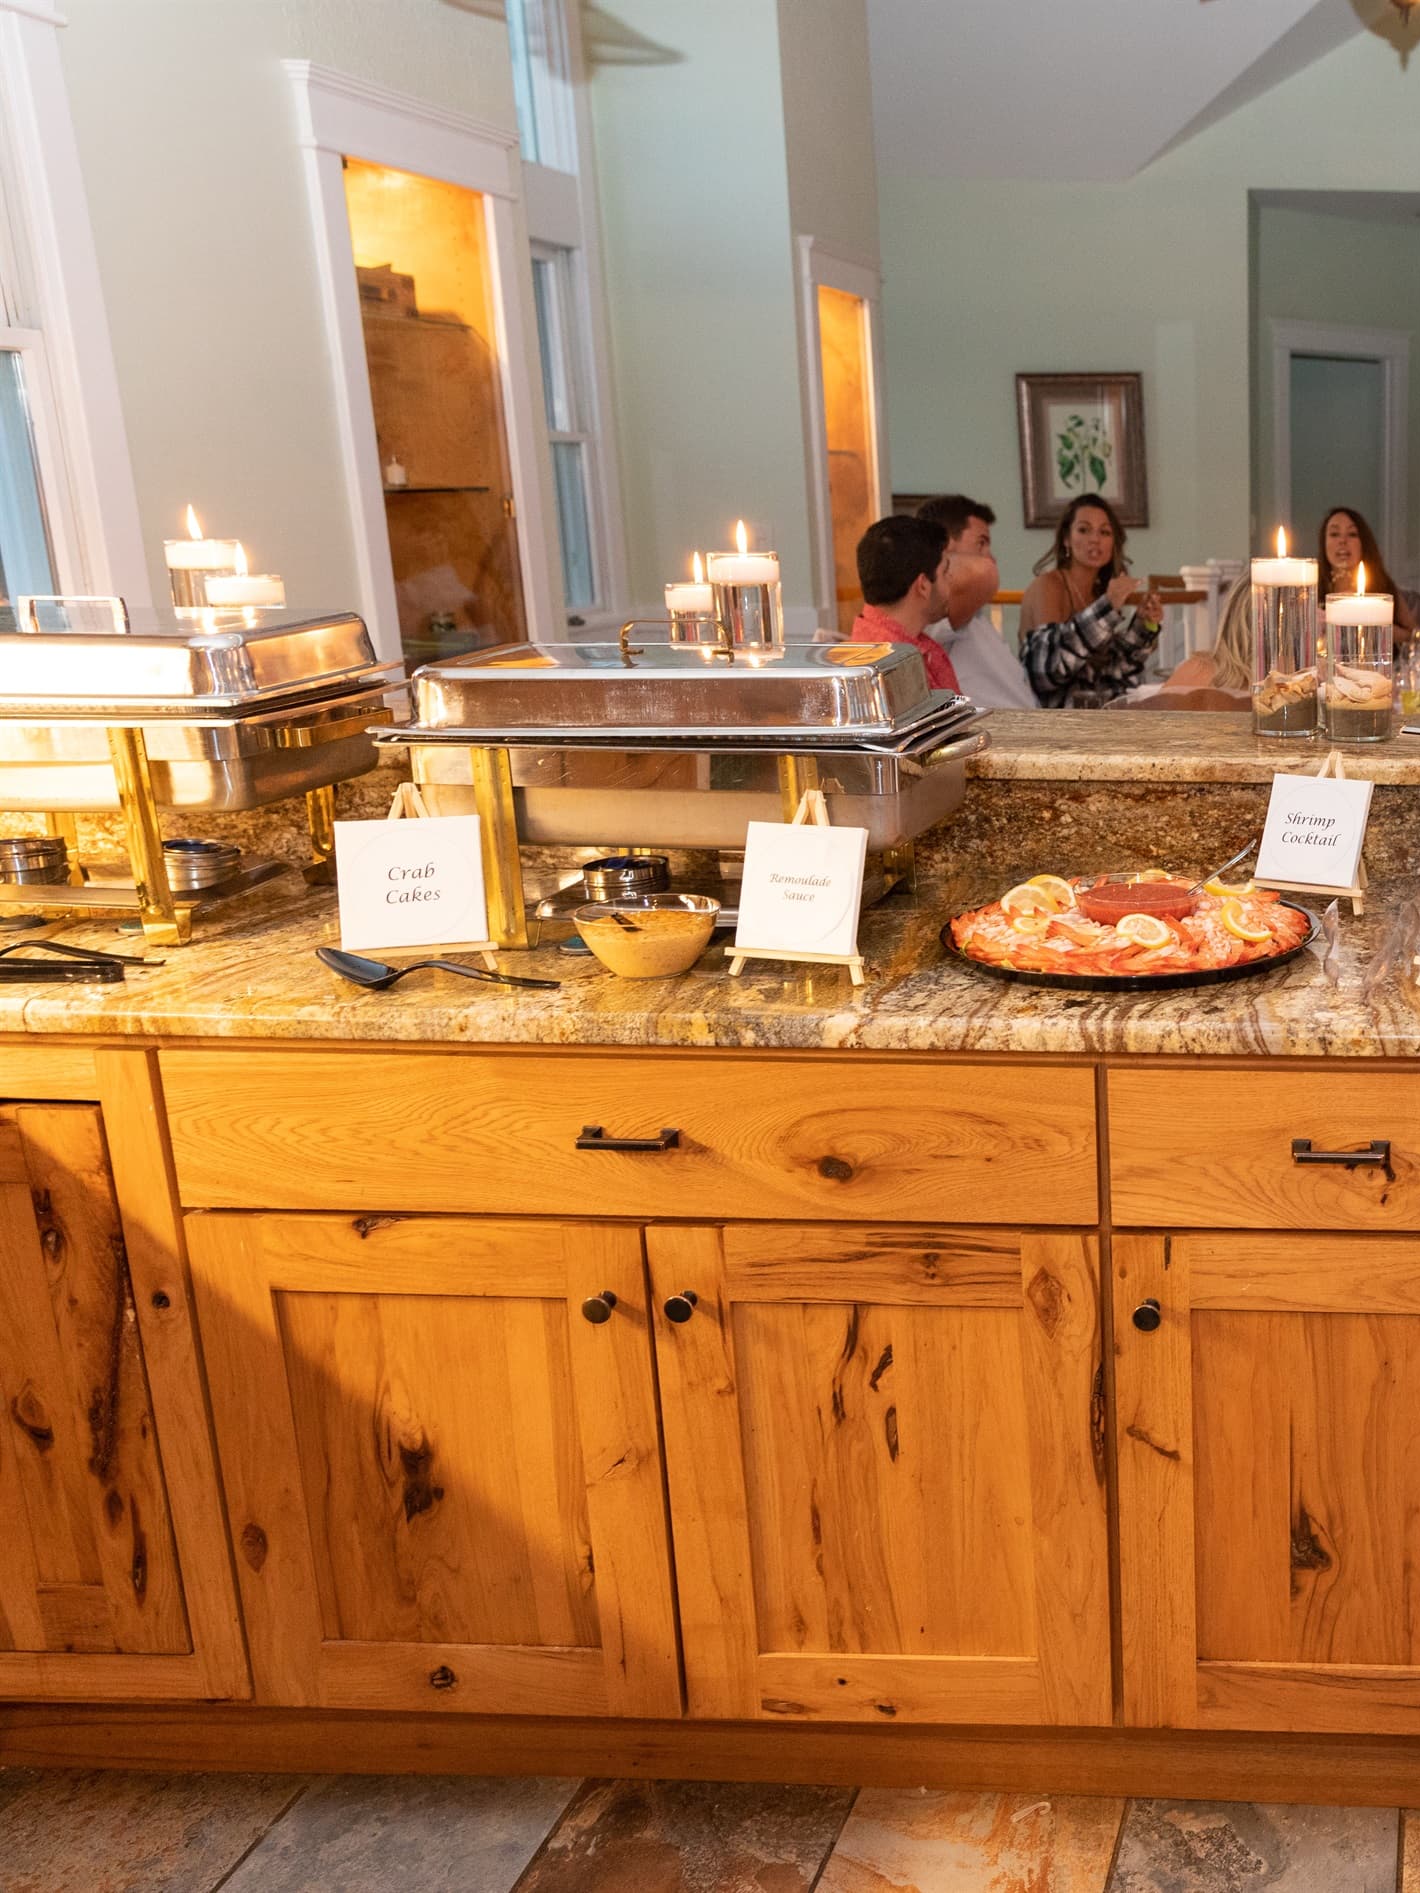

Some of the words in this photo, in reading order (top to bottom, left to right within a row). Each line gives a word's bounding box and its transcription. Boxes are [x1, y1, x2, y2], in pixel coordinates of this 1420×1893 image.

[1284, 812, 1336, 831] Shrimp
[1281, 831, 1341, 848] Cocktail
[387, 861, 435, 881] Crab
[769, 873, 832, 887] Remoulade
[386, 886, 441, 904] Cakes
[782, 890, 815, 902] Sauce
